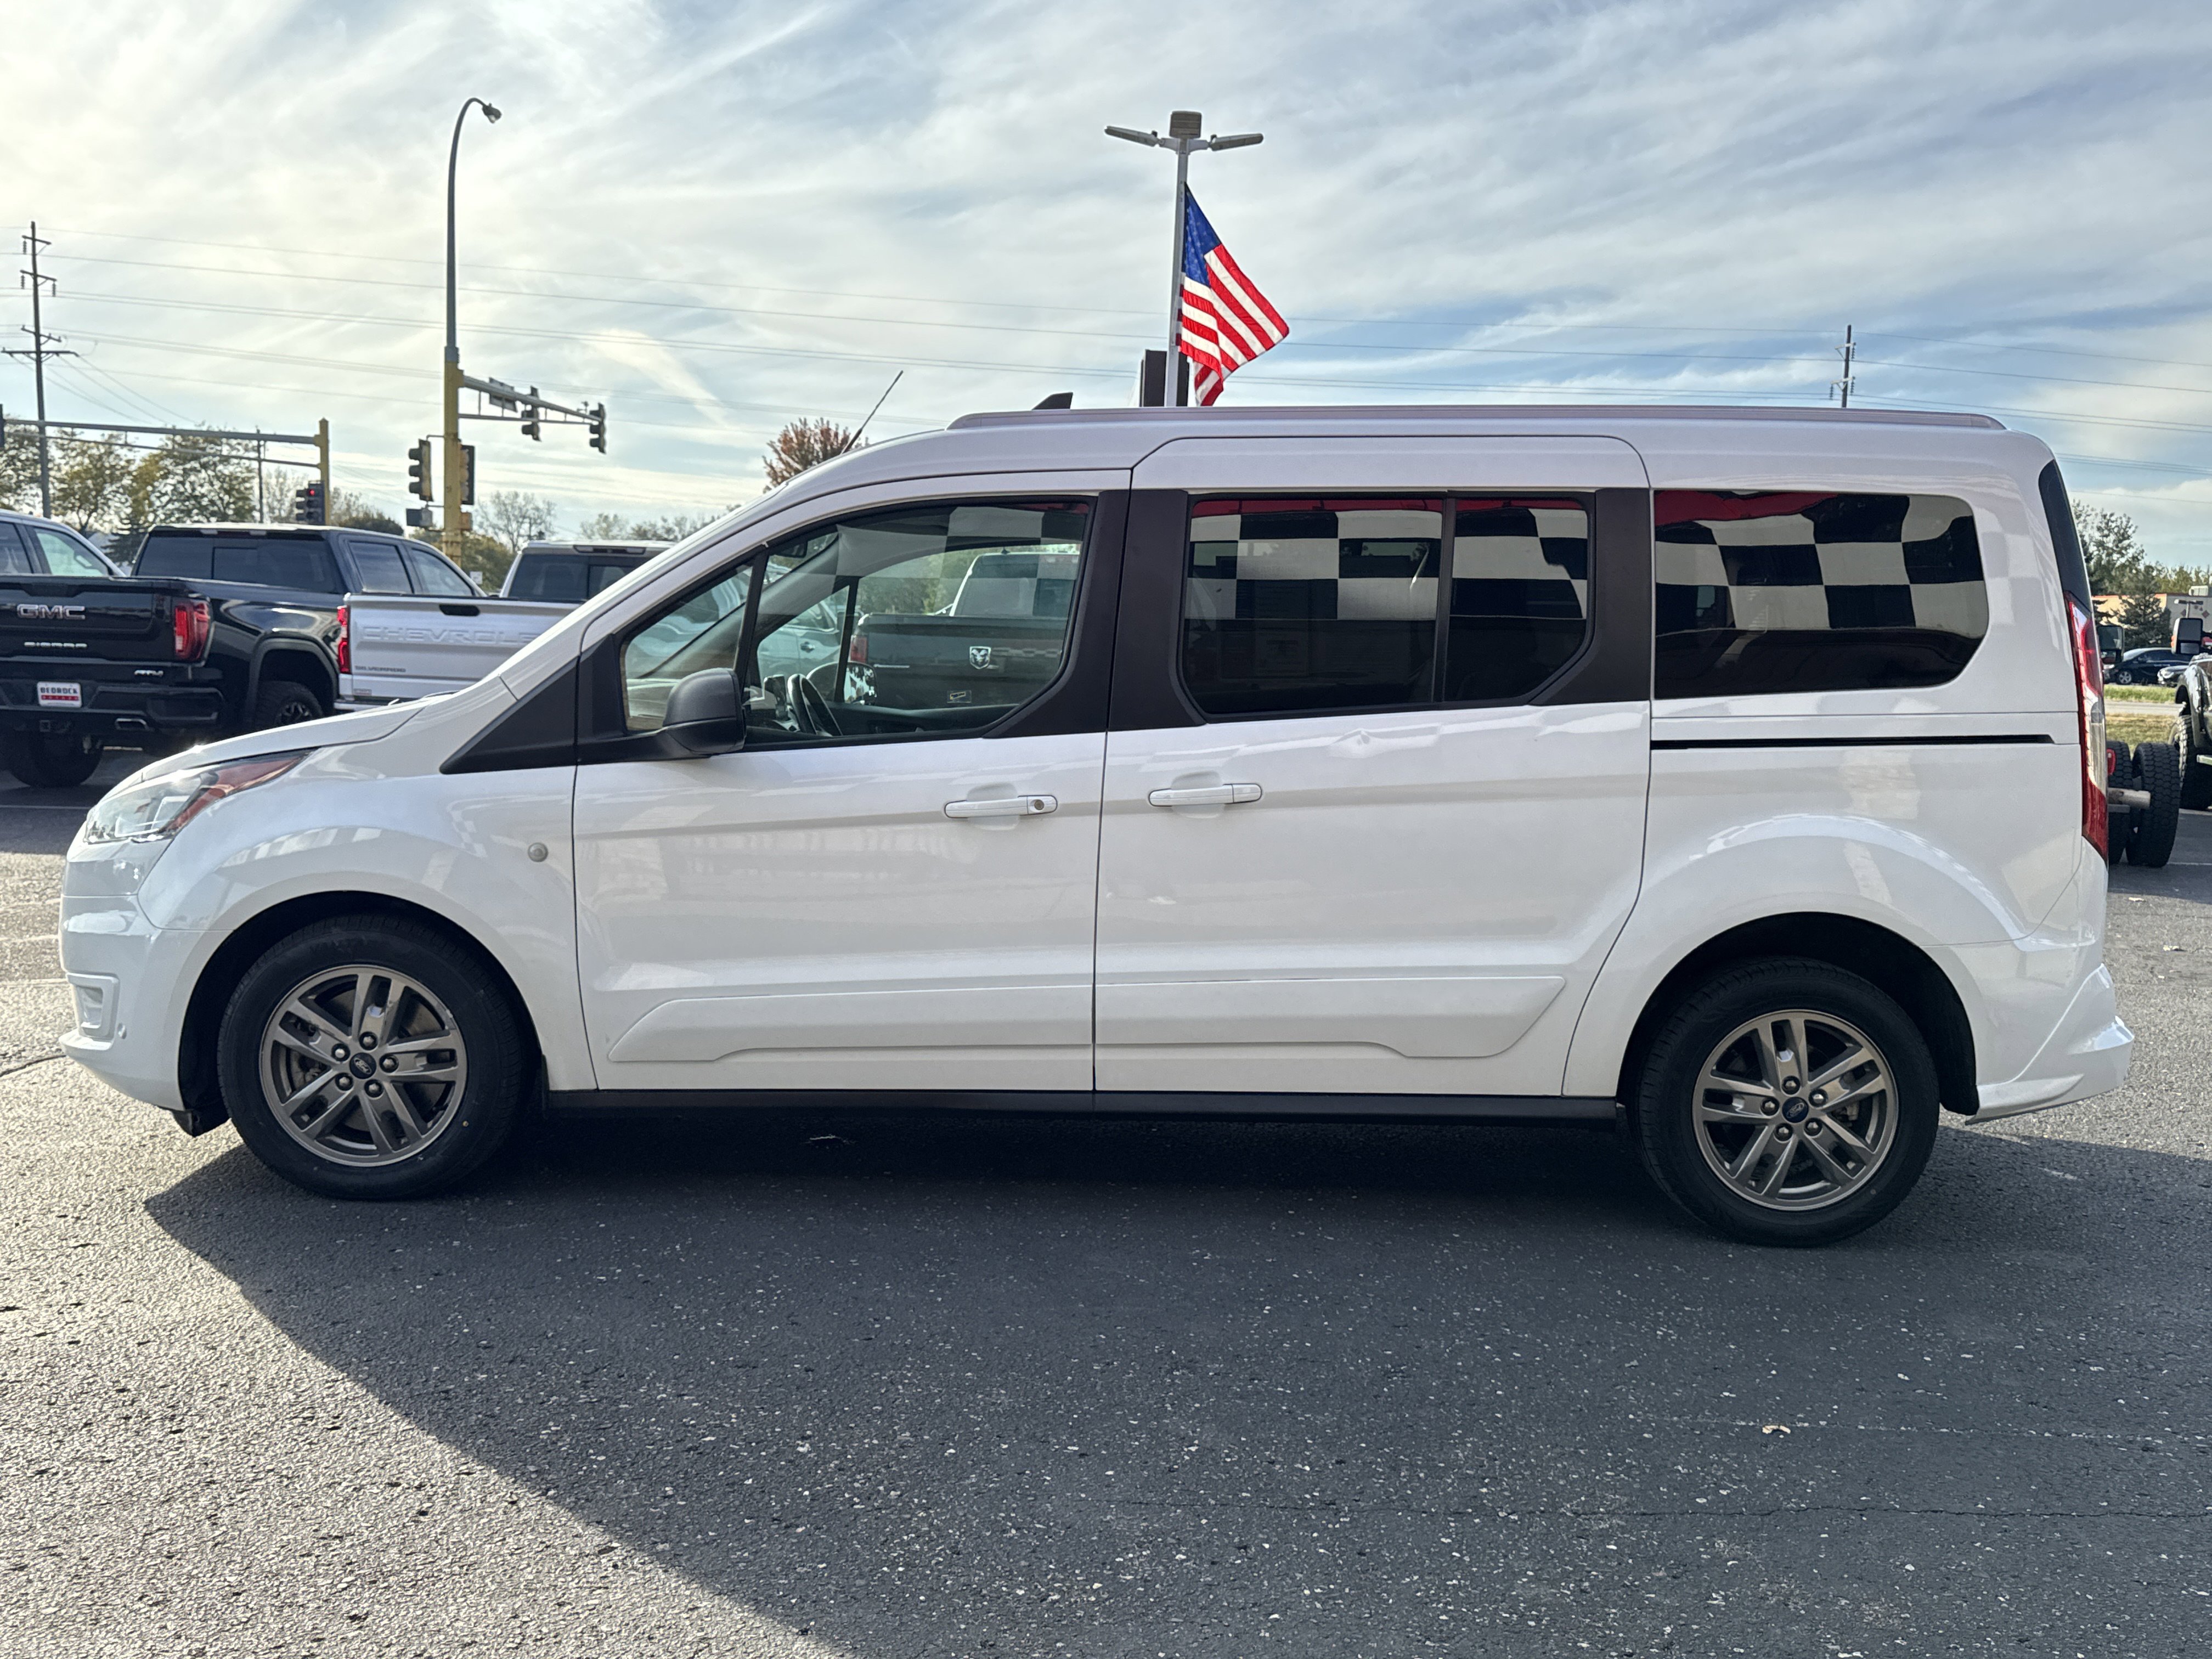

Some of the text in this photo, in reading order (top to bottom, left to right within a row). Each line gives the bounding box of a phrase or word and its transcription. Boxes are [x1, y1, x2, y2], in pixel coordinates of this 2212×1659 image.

[16, 604, 86, 620] GMC
[363, 626, 541, 646] CHEVROLE
[354, 1059, 370, 1074] Ford
